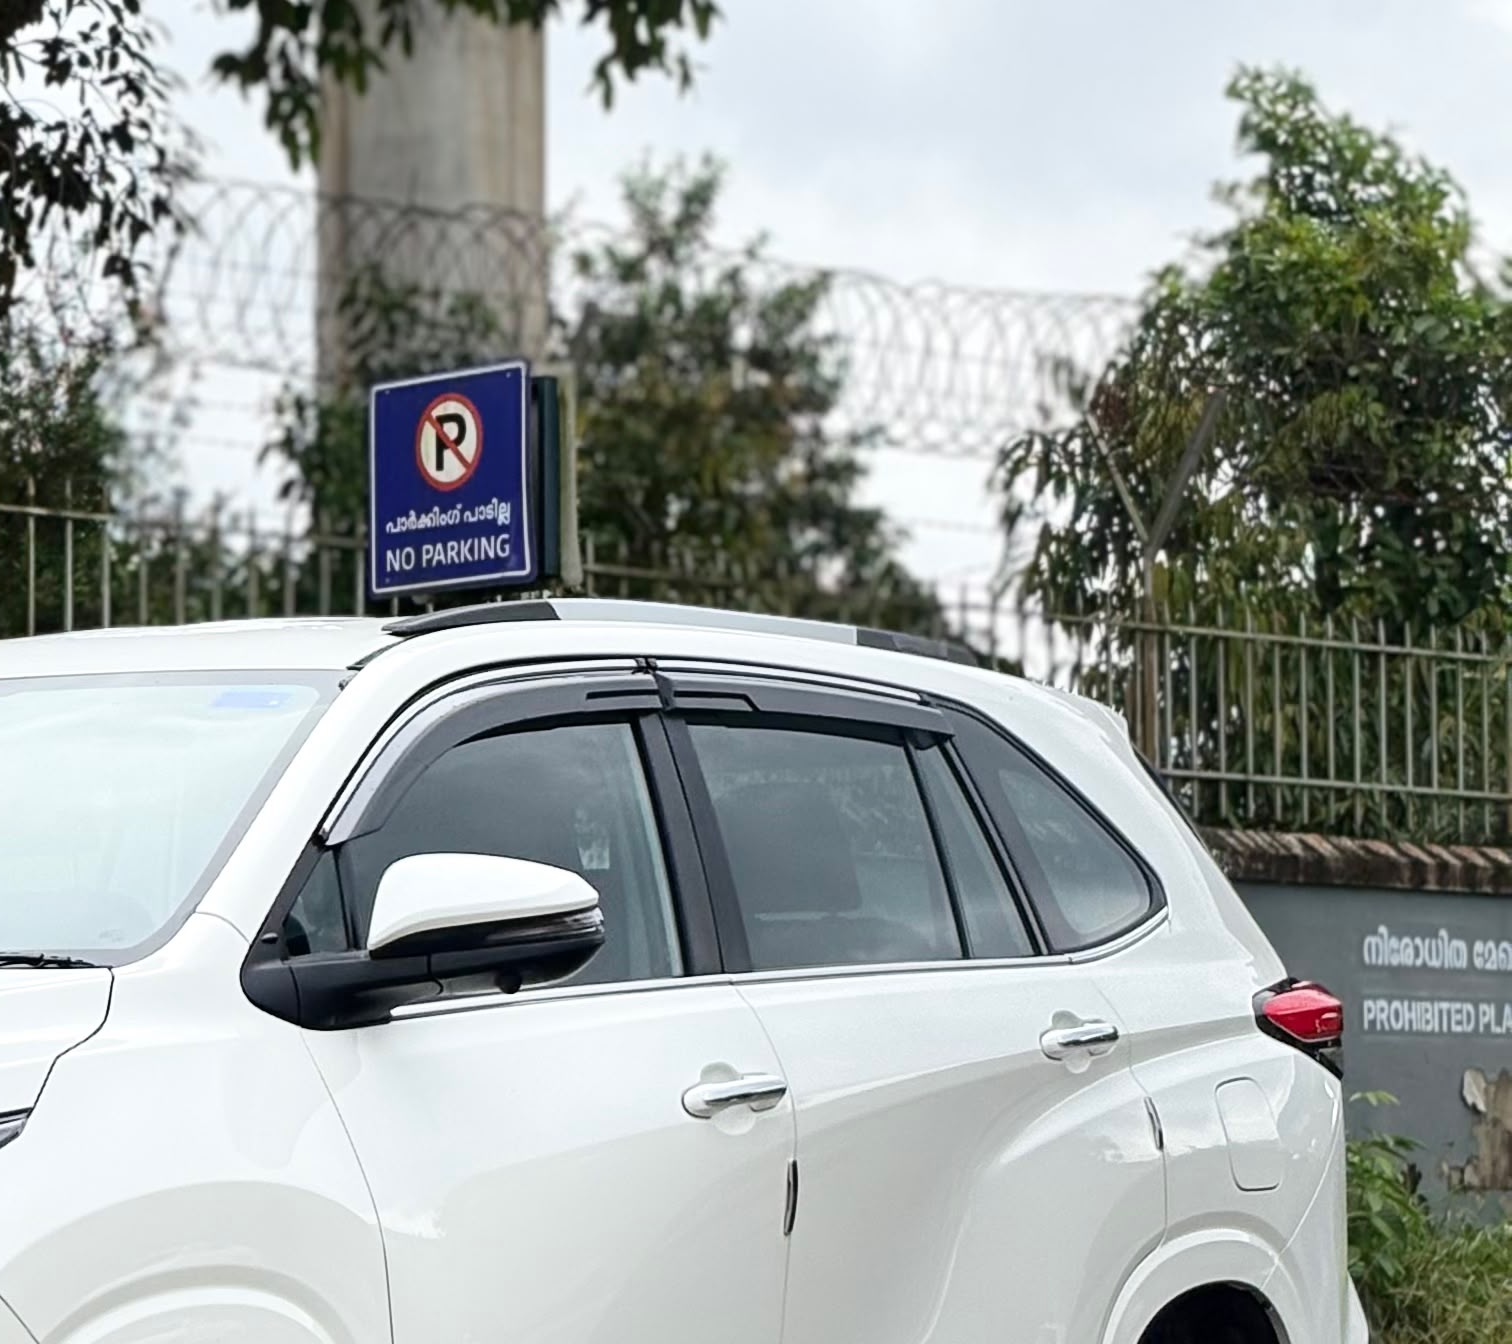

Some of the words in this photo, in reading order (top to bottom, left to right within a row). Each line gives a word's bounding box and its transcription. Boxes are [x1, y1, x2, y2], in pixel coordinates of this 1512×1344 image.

[464, 497, 511, 526] പാടില്ല
[386, 547, 416, 573] NO
[422, 534, 511, 567] PARKING
[1363, 999, 1475, 1033] PROHIBITED
